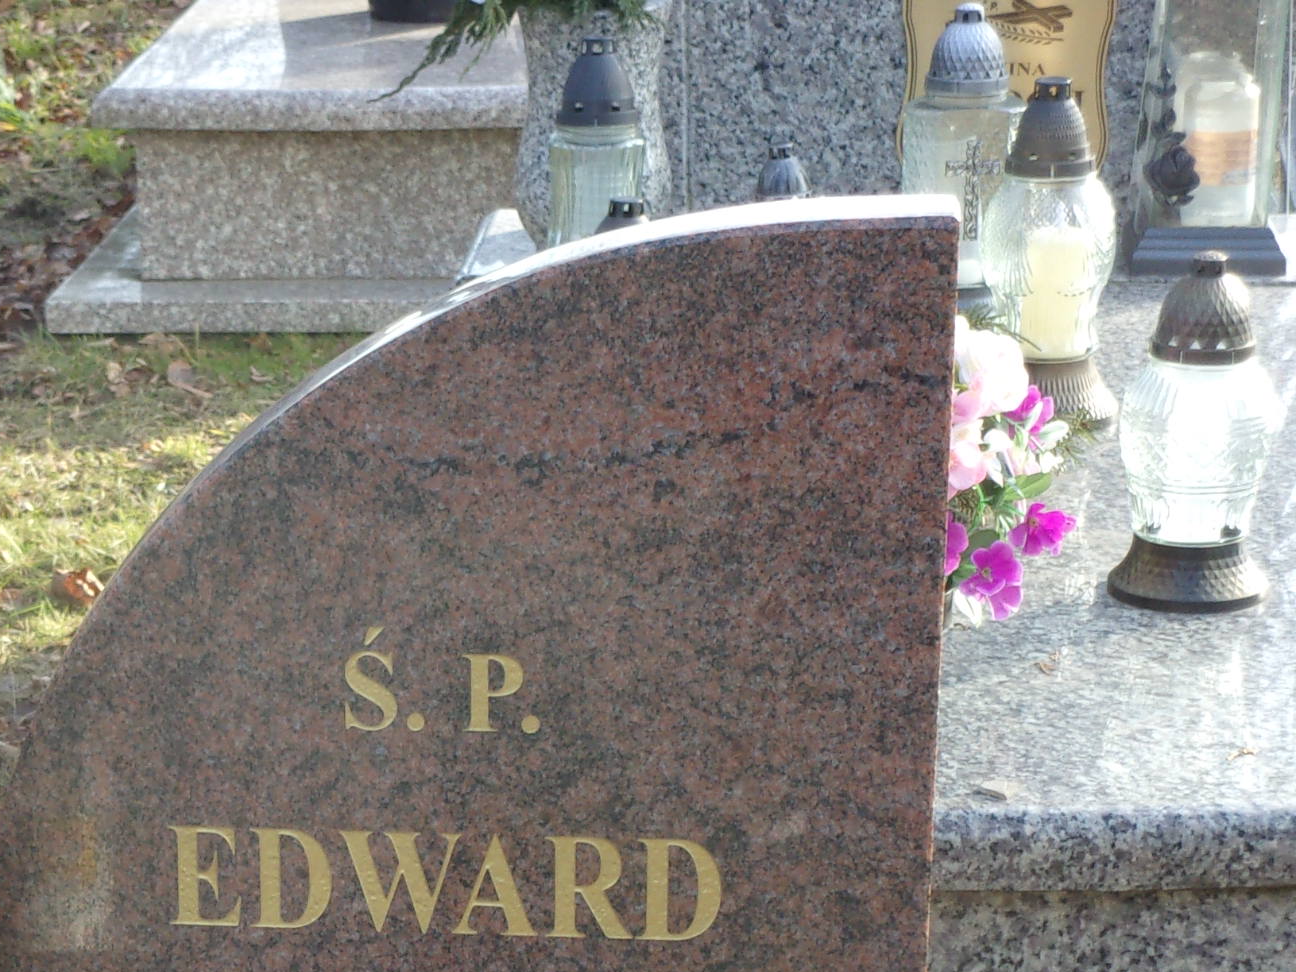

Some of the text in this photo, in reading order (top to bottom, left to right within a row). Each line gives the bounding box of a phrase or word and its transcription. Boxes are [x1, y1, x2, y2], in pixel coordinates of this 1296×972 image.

[344, 626, 542, 735] Ś. P.
[168, 825, 723, 942] EDWARD
